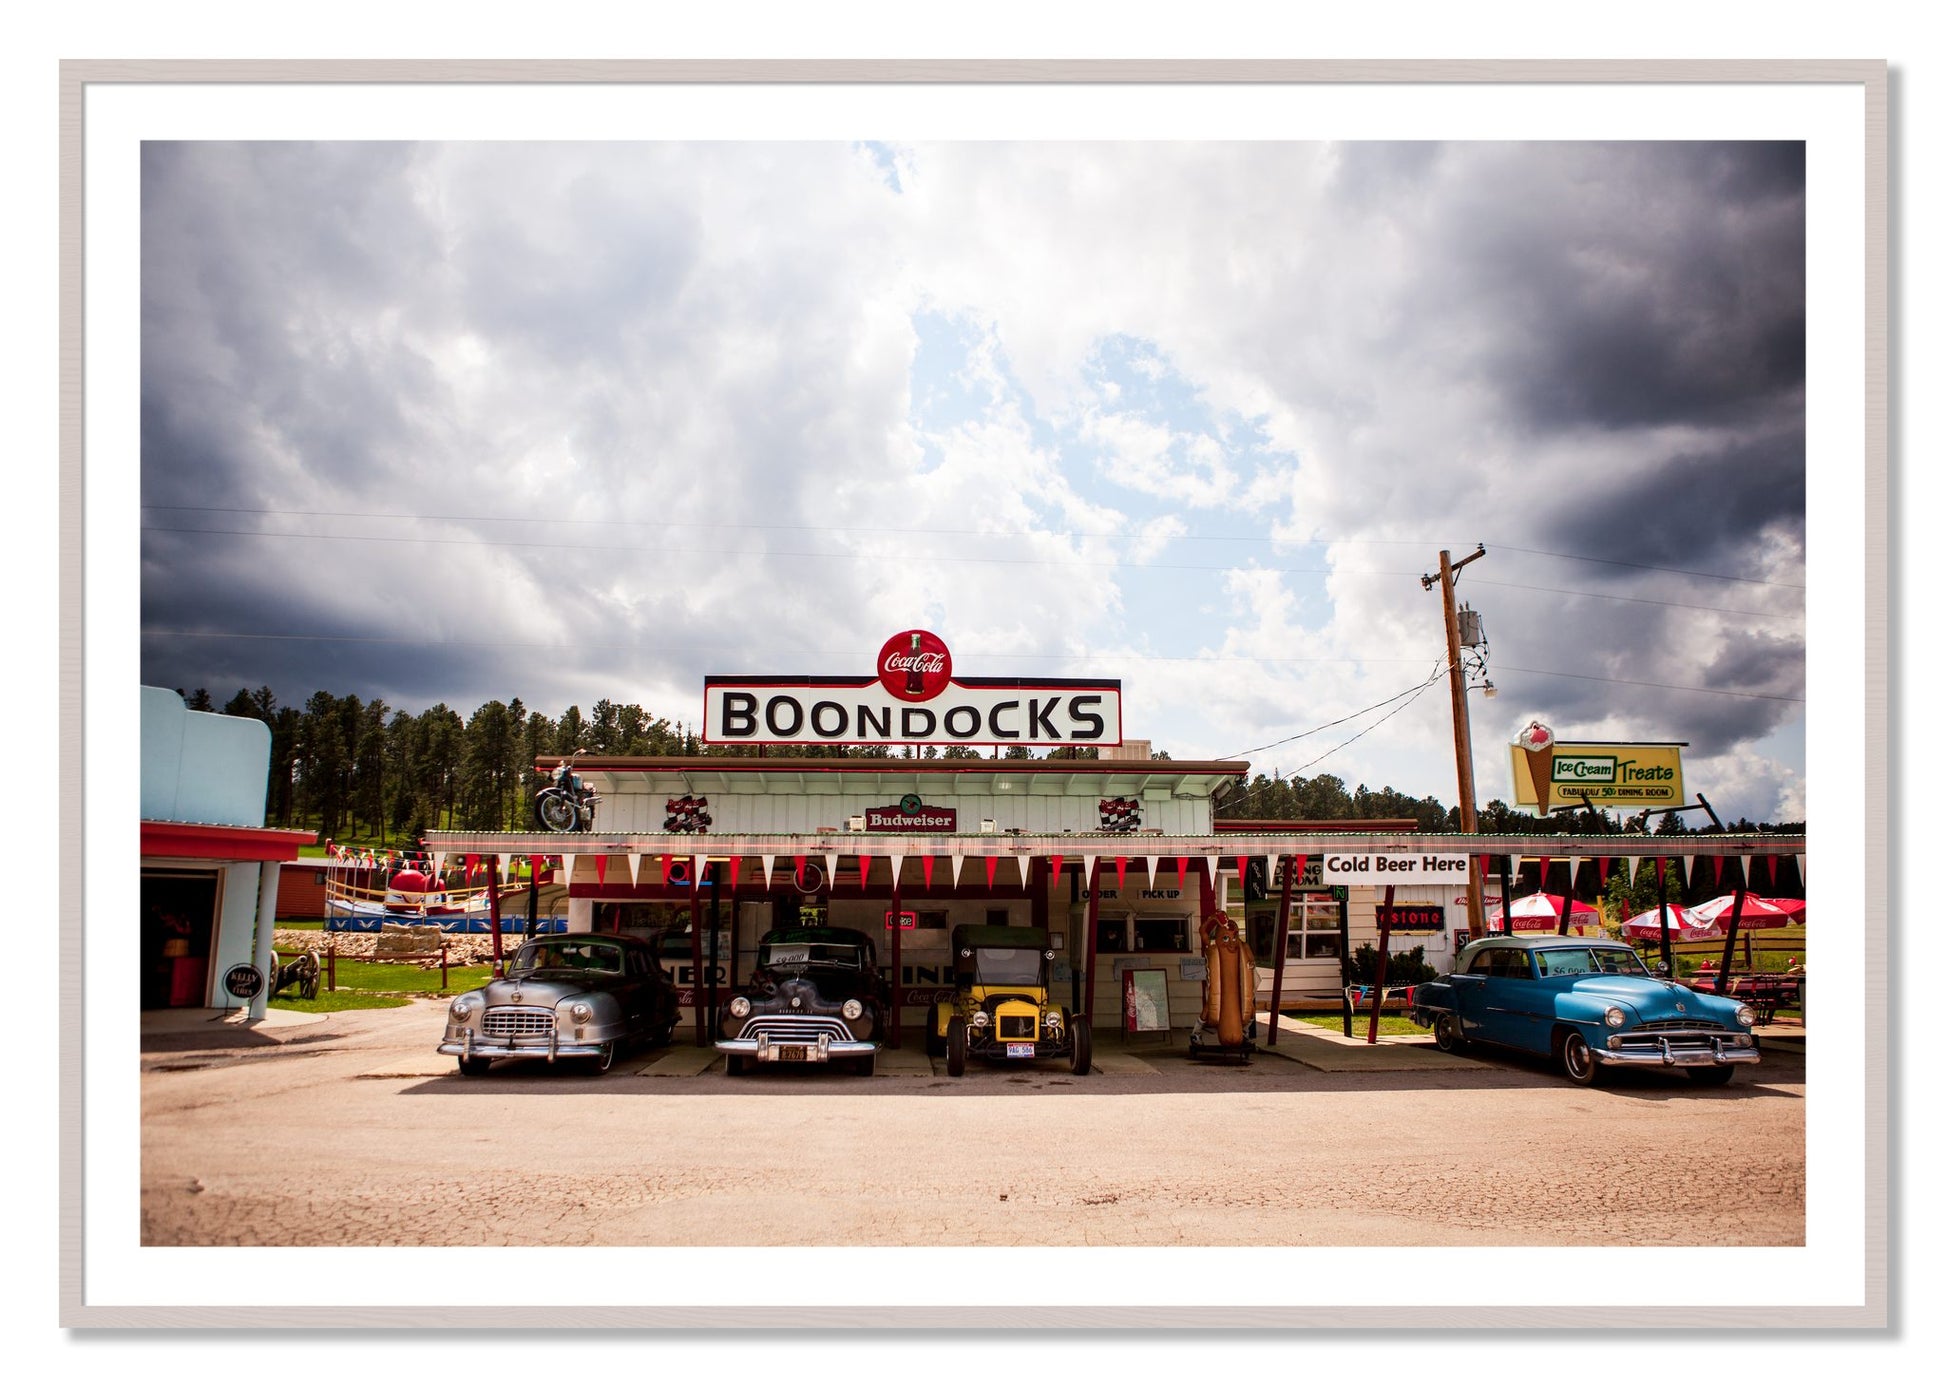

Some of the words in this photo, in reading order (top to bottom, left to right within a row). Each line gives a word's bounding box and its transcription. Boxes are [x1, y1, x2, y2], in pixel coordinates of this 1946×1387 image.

[884, 651, 946, 673] Coca-Cola
[721, 691, 1105, 740] BOONDOCKS
[1556, 761, 1574, 775] Ice
[1573, 761, 1612, 777] Cream
[1617, 759, 1674, 783] Treats
[1562, 788, 1600, 796] FABULOUS
[1618, 788, 1644, 796] DINING
[1645, 788, 1669, 796] ROOM
[869, 813, 953, 827] Budweiser
[1275, 864, 1322, 876] DNNG
[1327, 856, 1370, 873] Cold
[1376, 856, 1417, 872] Beer
[1422, 855, 1466, 872] Here
[1275, 875, 1319, 886] ROM
[1082, 890, 1118, 899] ODER
[1142, 890, 1164, 899] PICK
[1166, 890, 1180, 899] UP
